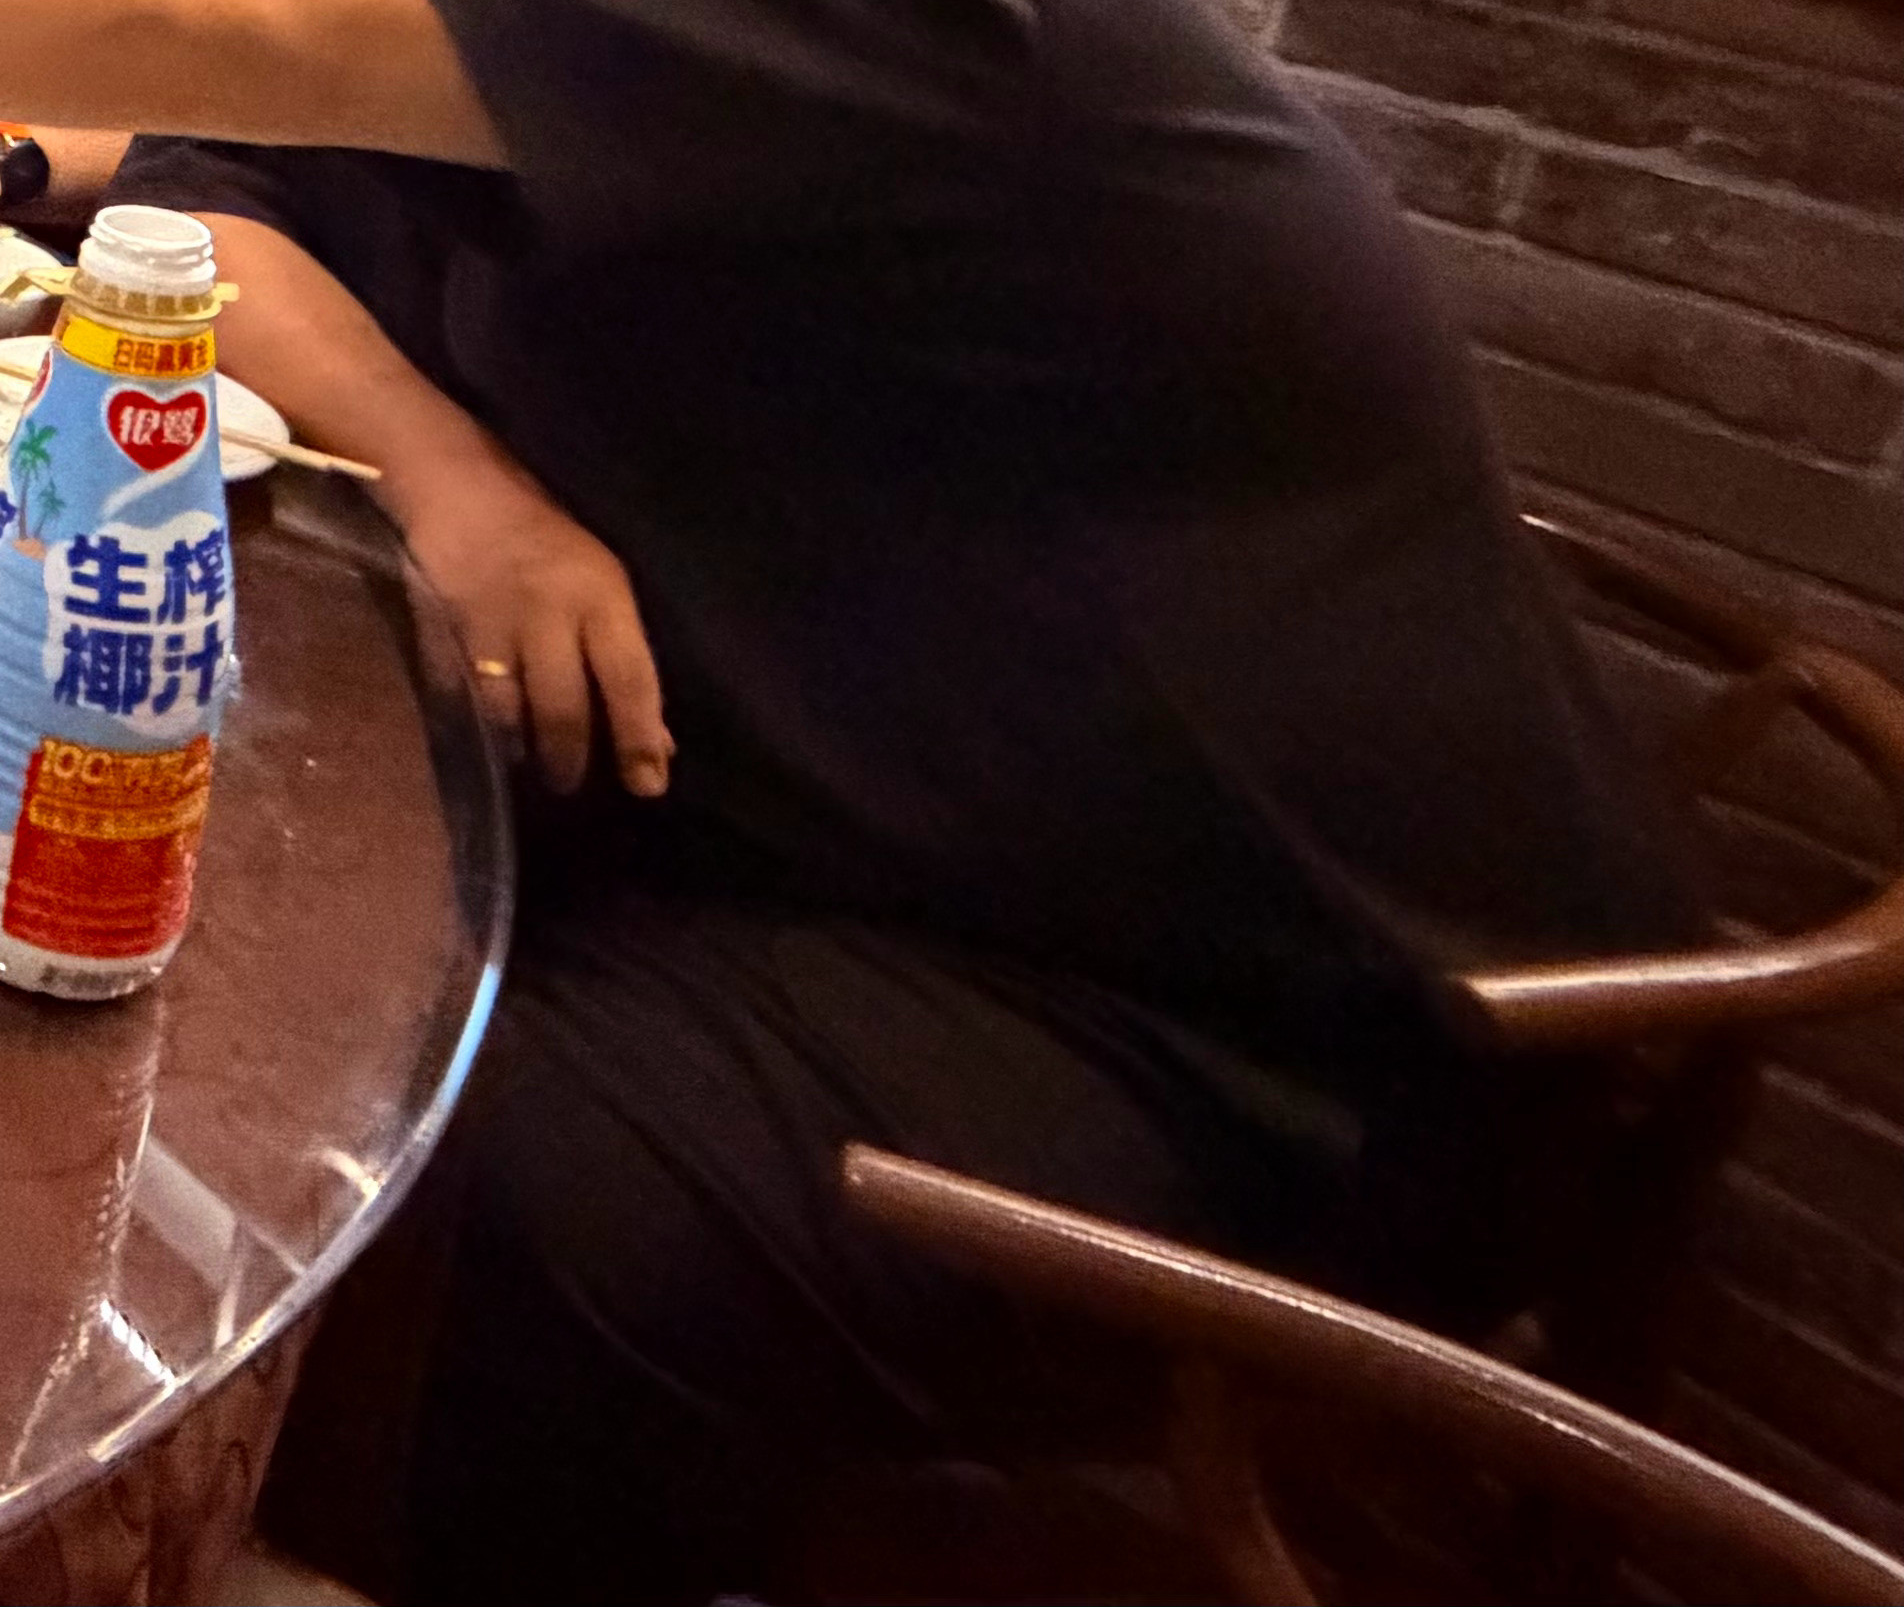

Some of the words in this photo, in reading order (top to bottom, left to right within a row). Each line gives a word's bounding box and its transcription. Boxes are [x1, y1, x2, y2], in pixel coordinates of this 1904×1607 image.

[119, 405, 200, 447] 银鹭
[62, 527, 226, 625] 生榨
[53, 620, 225, 716] 椰汁
